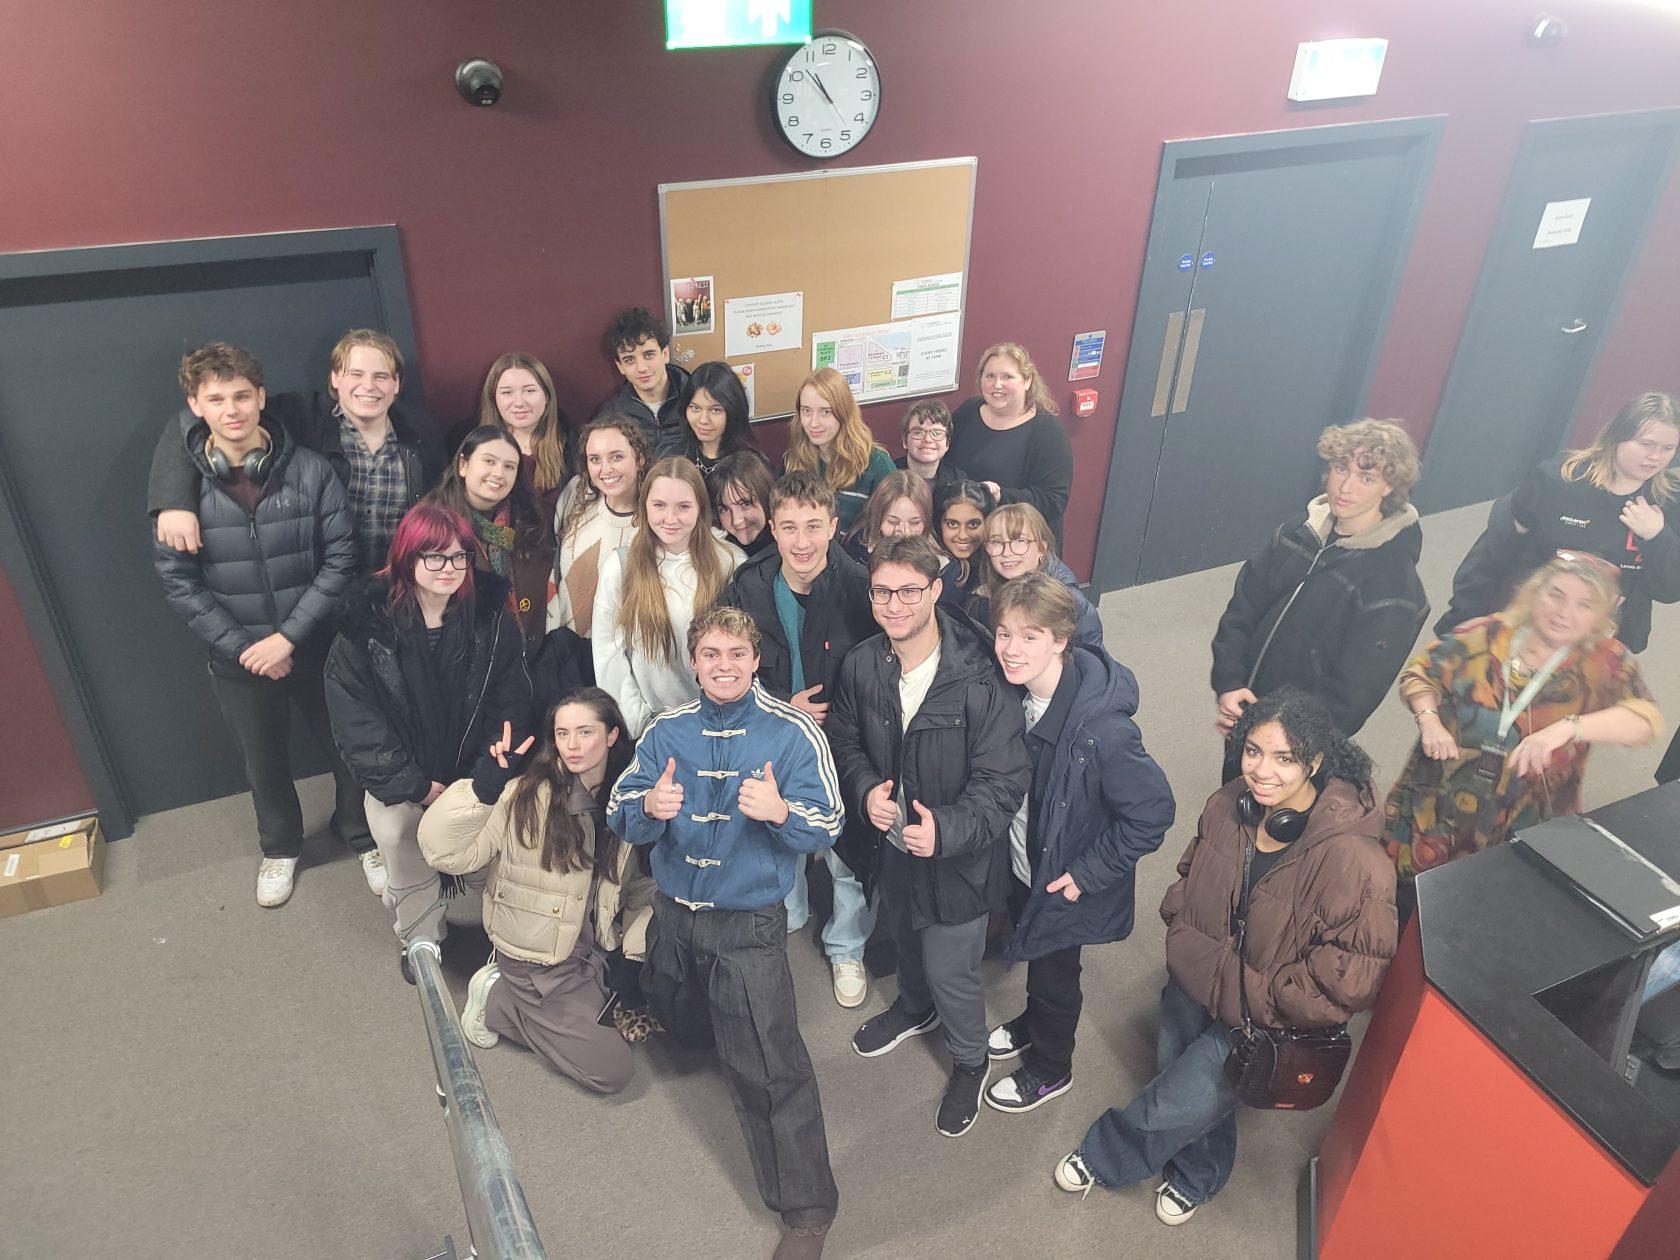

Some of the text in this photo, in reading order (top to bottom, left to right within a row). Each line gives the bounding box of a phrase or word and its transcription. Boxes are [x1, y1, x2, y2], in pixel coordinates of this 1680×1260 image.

[822, 43, 837, 55] 12
[806, 51, 815, 63] 11
[848, 50, 852, 62] 1
[789, 70, 804, 82] 10
[856, 67, 868, 79] 2
[782, 93, 794, 104] 9
[860, 90, 872, 101] 3
[788, 116, 799, 127] 8
[854, 112, 864, 123] 4
[802, 133, 814, 144] 7
[840, 130, 851, 141] 5
[821, 138, 832, 149] 6
